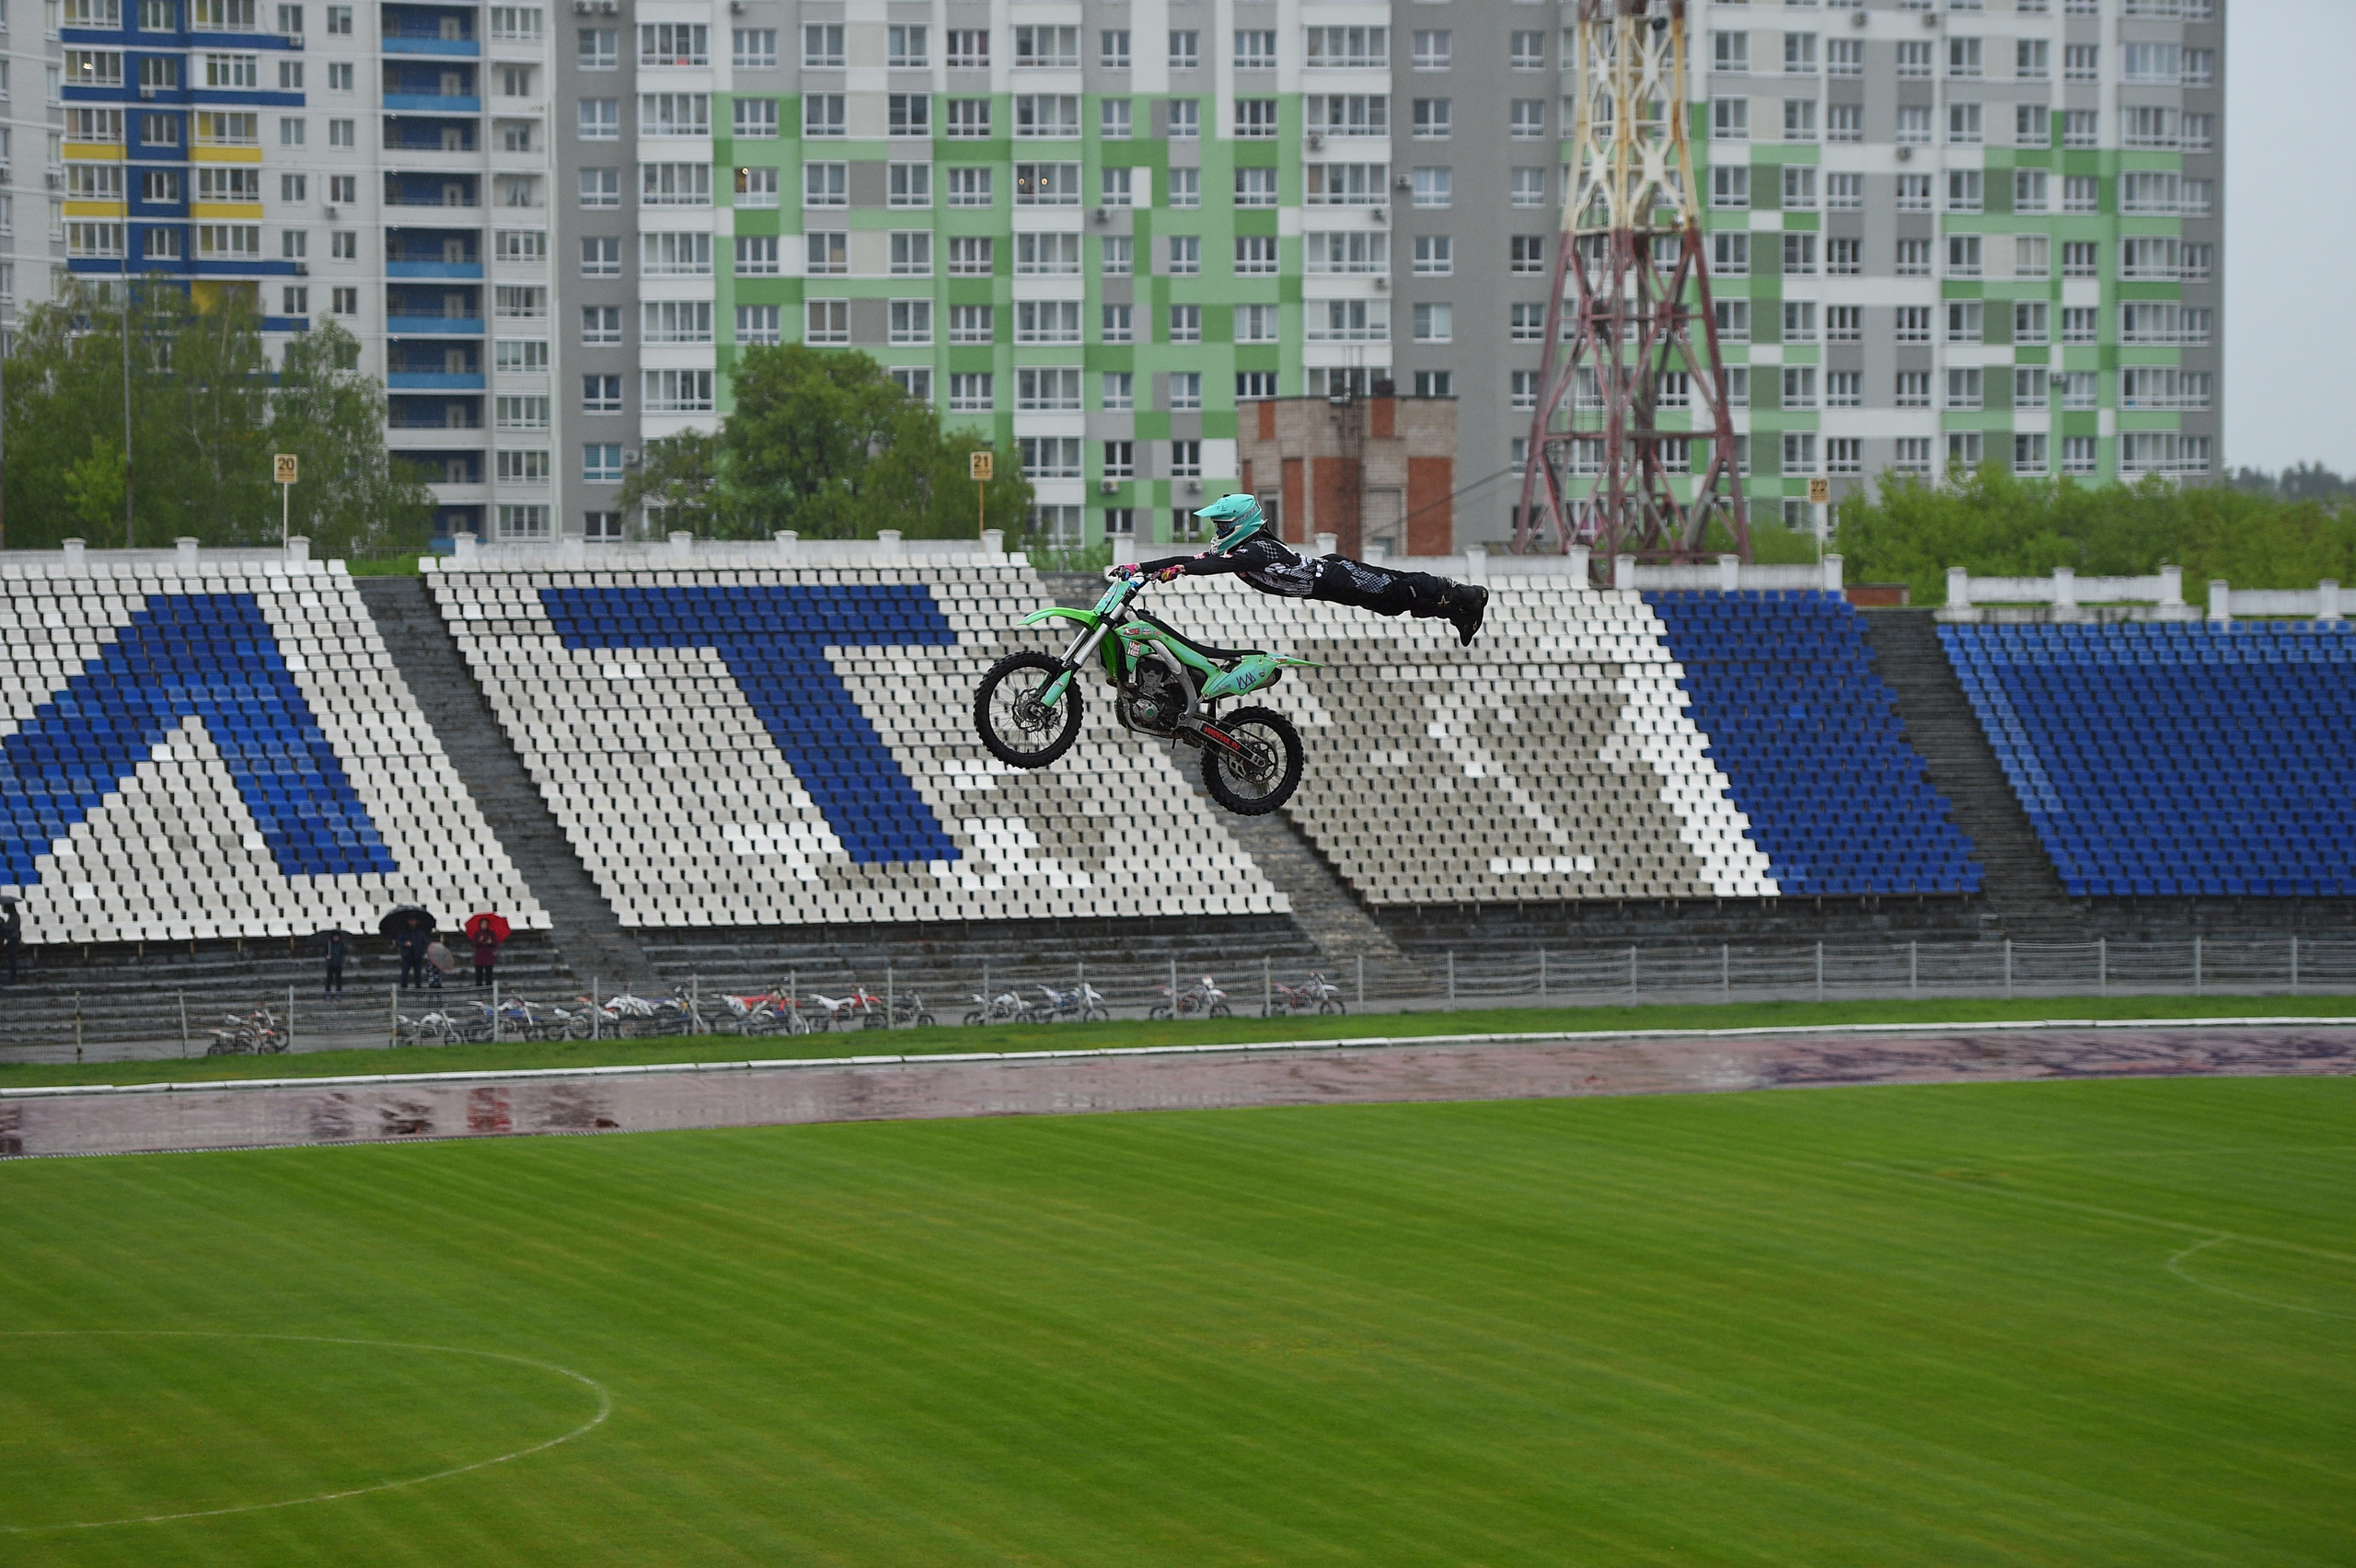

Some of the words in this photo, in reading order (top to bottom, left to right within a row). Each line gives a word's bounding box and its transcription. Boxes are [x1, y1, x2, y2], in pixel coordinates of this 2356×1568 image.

[278, 457, 294, 470] 20
[974, 455, 988, 467] 21
[1811, 479, 1827, 492] 22
